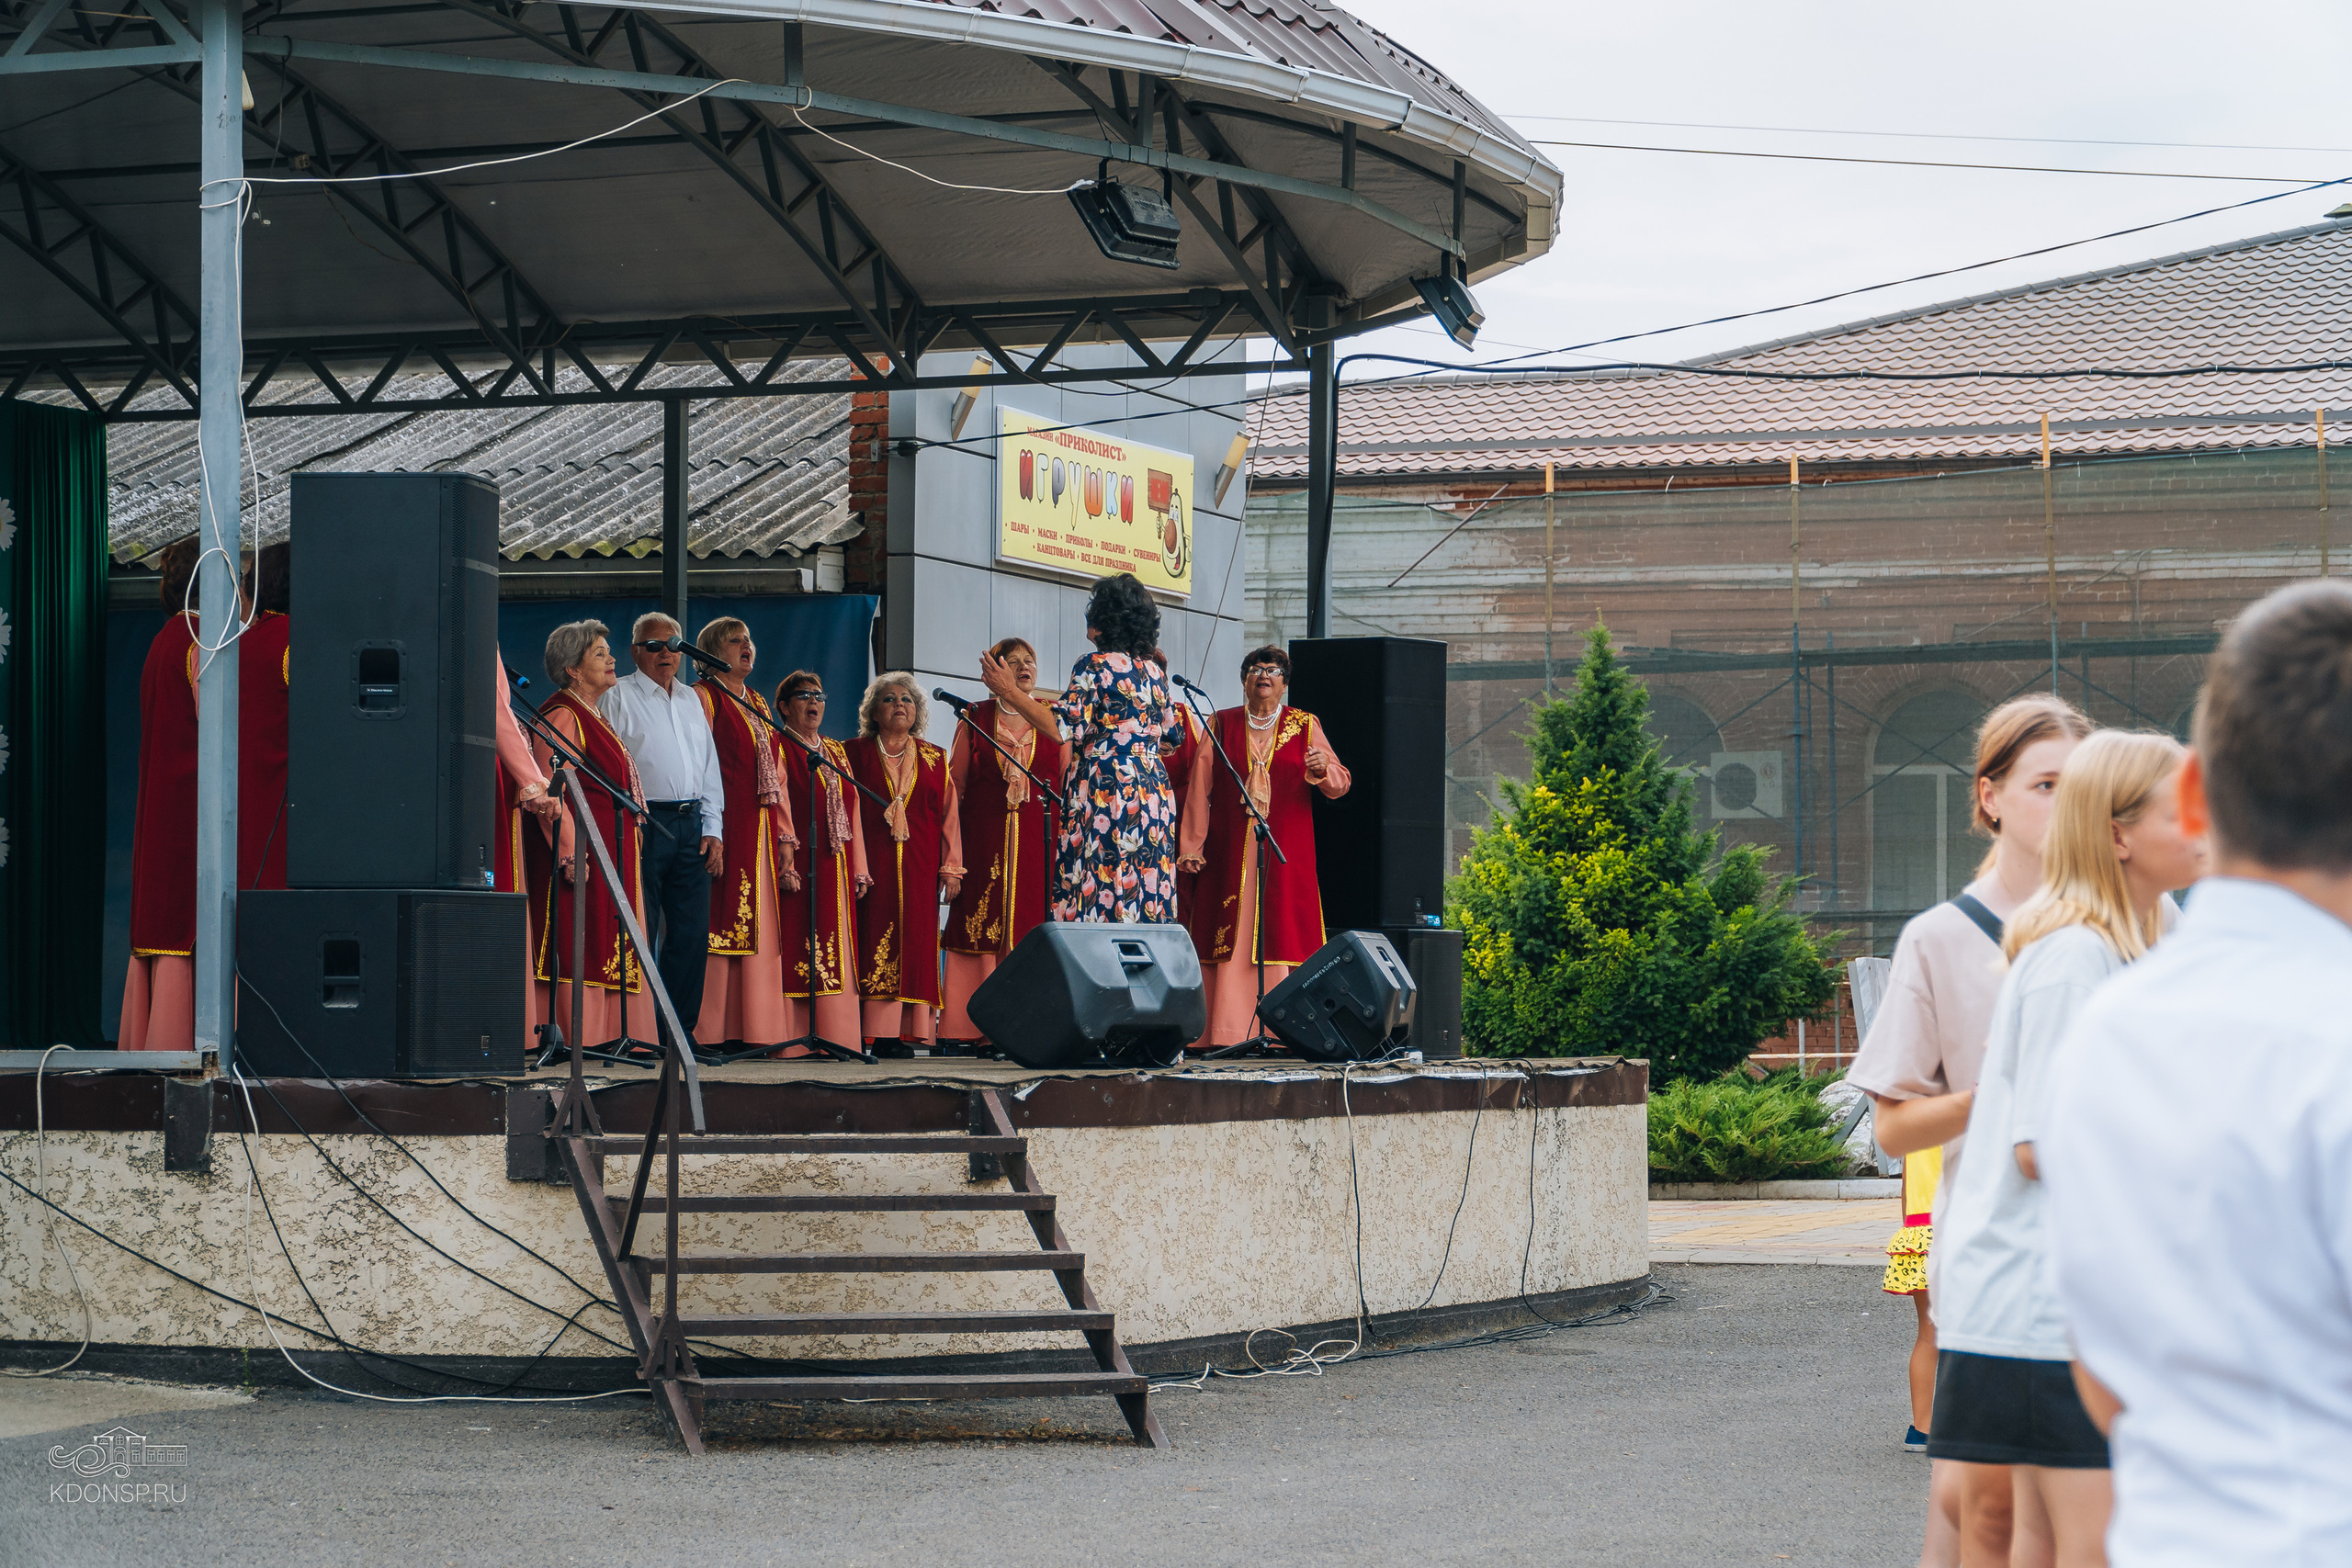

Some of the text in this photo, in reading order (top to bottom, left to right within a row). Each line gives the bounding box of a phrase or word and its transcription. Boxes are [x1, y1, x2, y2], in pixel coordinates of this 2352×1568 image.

[1055, 432, 1126, 461] «ПРИКОЛИСТ»
[1019, 449, 1134, 531] ИГРУШКИ
[1011, 521, 1161, 563] ШАРЫ МАСКИ ПРИКОЛЫ ПОДАРКИ СУВЕНИРЫ
[1036, 543, 1137, 573] КАНЦТОВАРЫ ВСЕ ДЛЯ ПРАЗДНИКА
